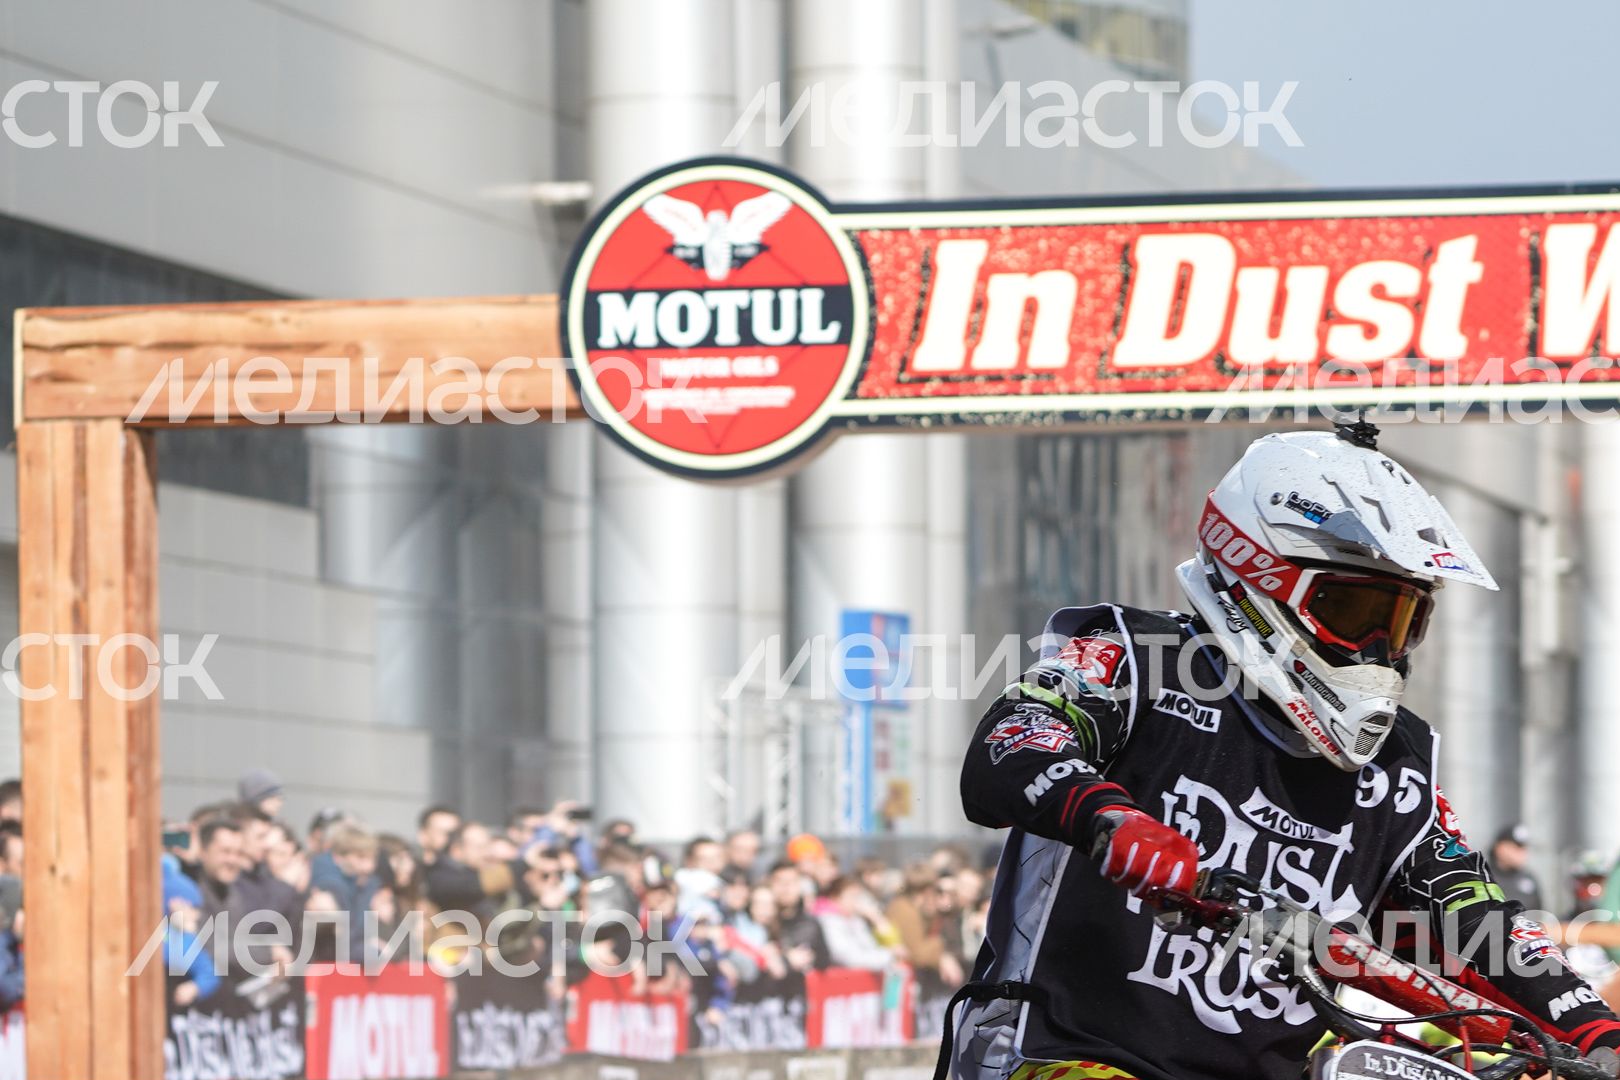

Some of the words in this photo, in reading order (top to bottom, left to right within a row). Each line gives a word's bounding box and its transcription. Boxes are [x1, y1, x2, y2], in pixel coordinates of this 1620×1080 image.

[597, 288, 842, 348] MOTUL
[912, 239, 1078, 372] In
[1113, 233, 1483, 368] Dust
[1289, 491, 1333, 519] GoPr
[1201, 513, 1292, 591] 100%
[1287, 702, 1342, 756] MALOSSI
[1355, 762, 1428, 814] 95
[1249, 805, 1316, 839] MOTUL
